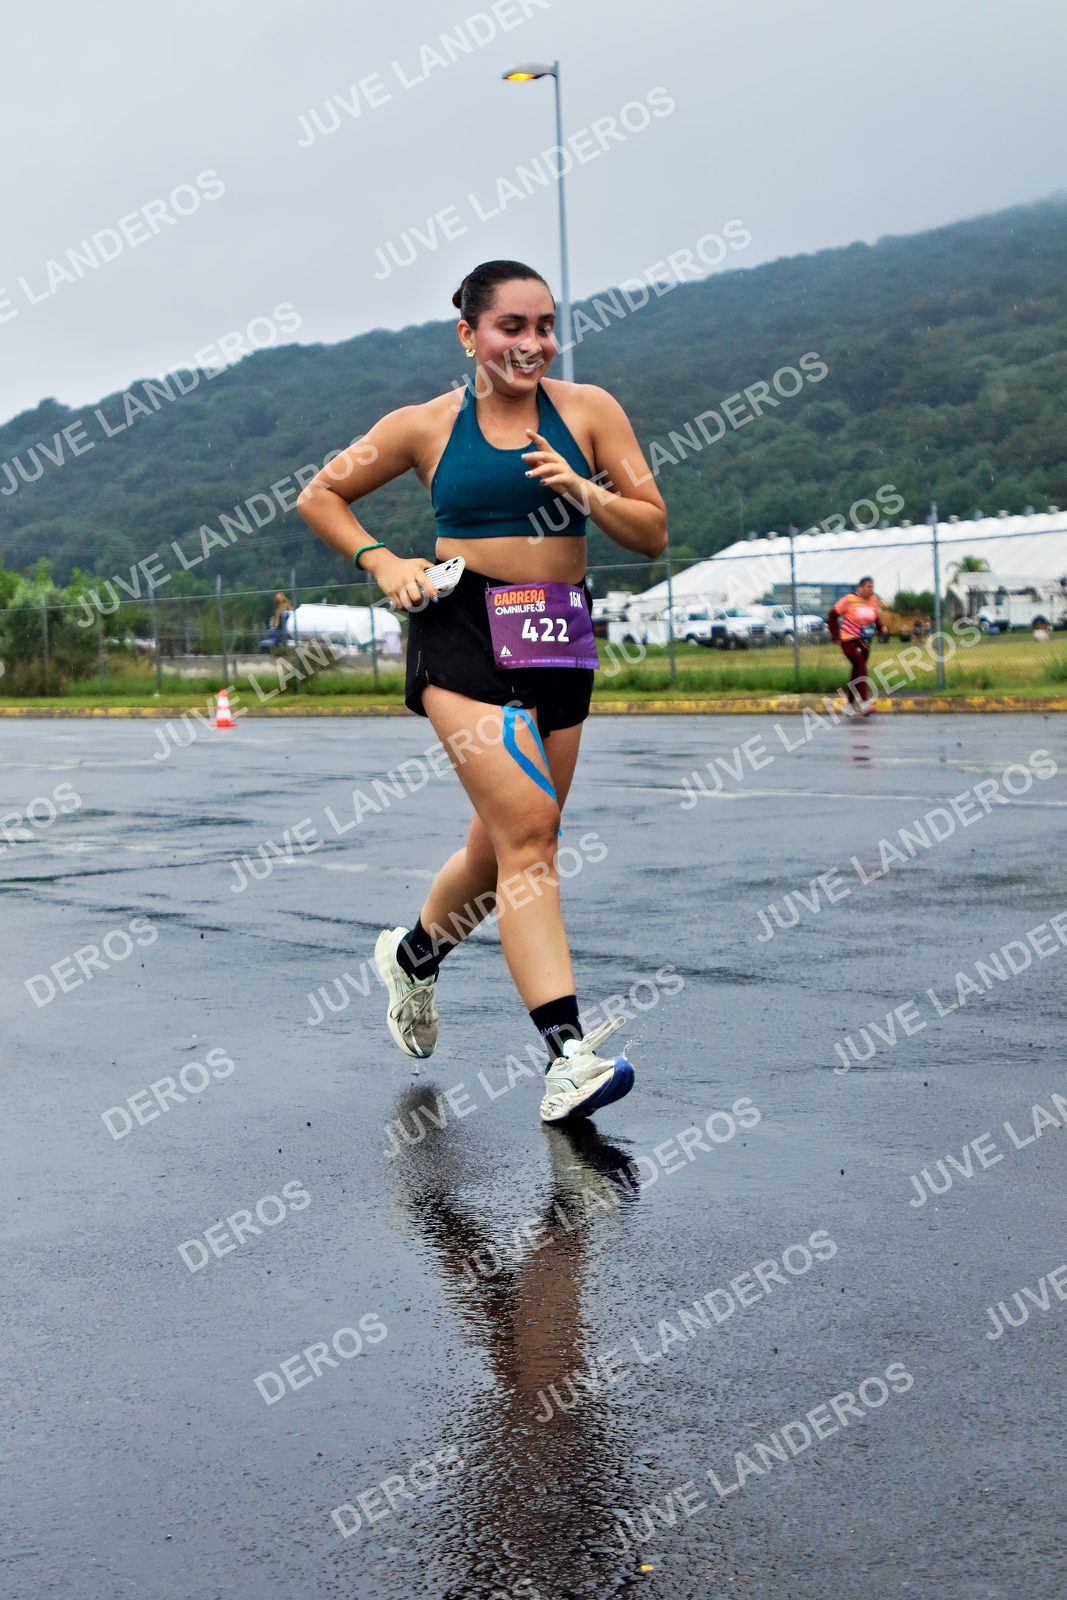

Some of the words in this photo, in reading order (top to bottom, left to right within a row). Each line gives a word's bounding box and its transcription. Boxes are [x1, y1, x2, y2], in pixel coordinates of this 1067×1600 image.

[493, 588, 546, 606] CARRERA
[495, 604, 535, 615] OMNILIFE
[521, 617, 570, 643] 422
